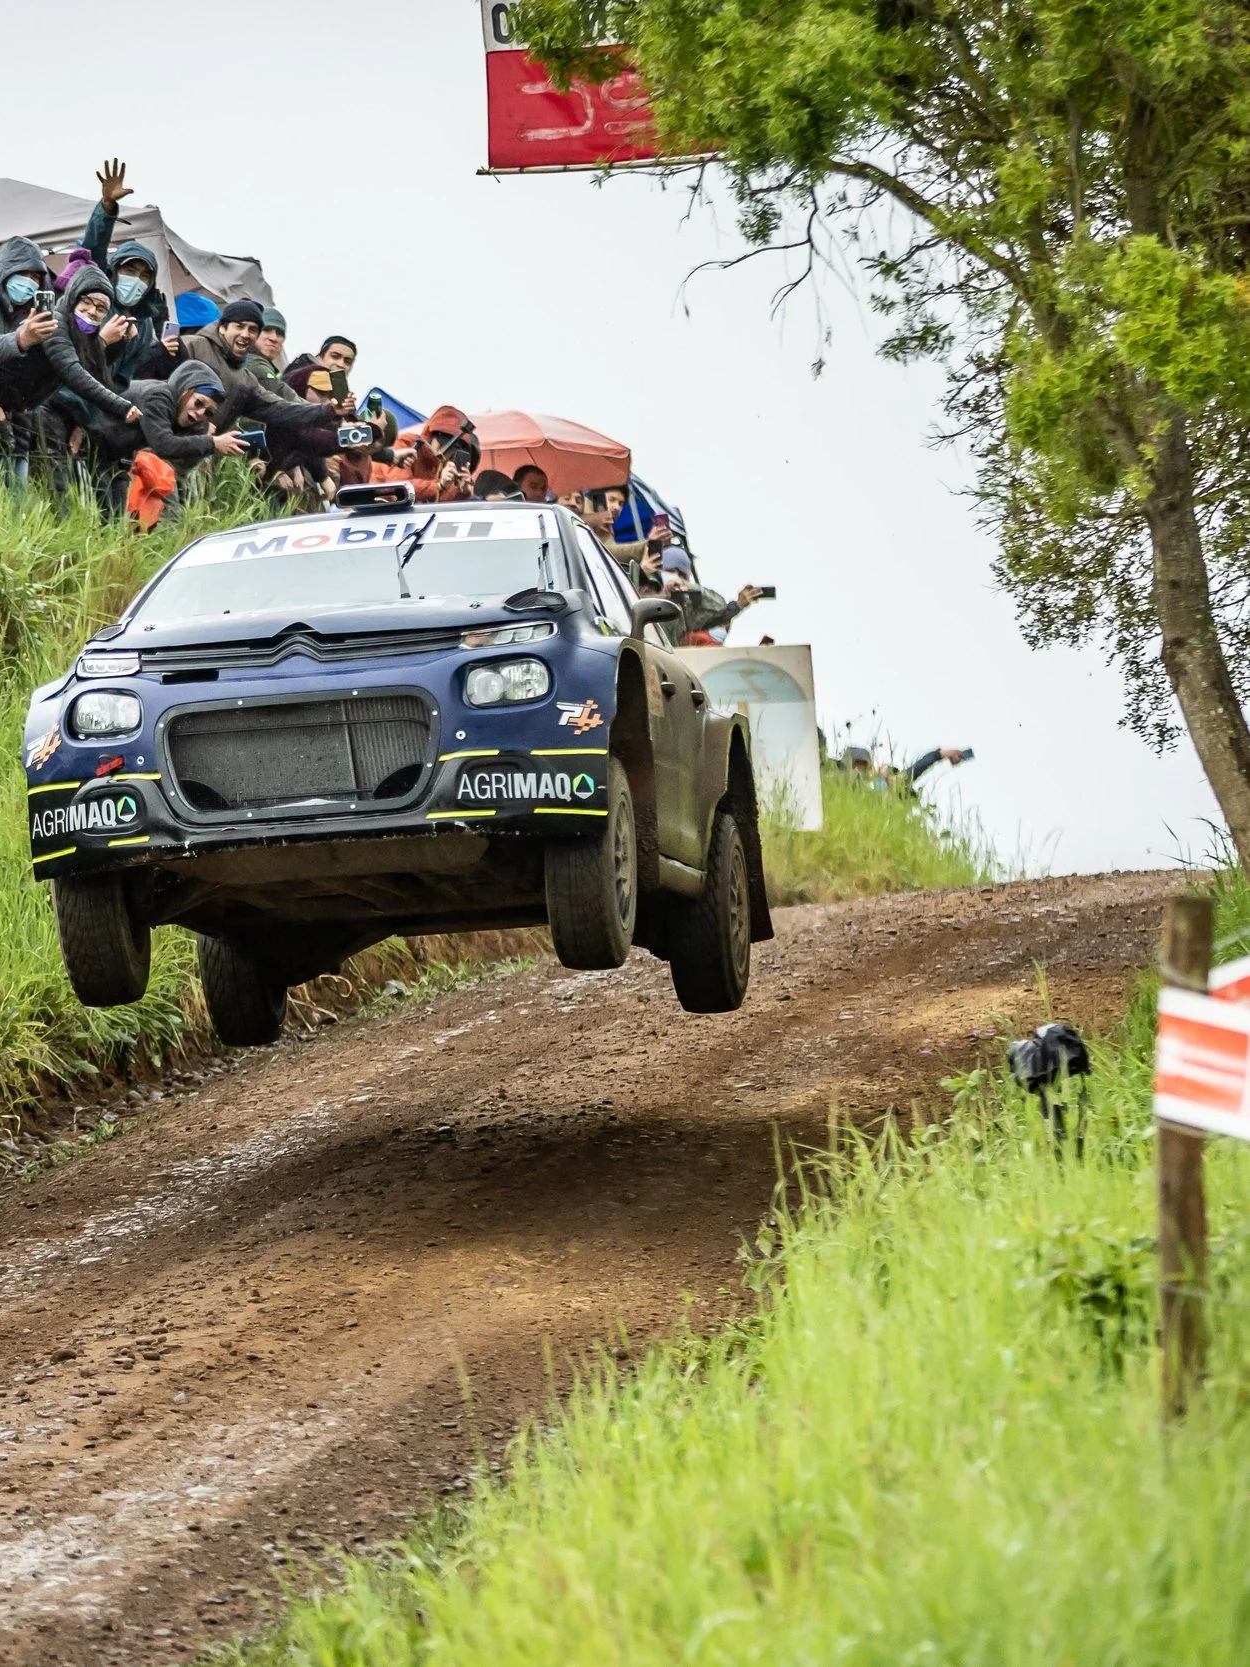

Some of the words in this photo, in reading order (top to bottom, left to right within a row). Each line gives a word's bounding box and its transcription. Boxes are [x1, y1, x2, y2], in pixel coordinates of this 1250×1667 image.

[232, 522, 418, 559] Mobil
[457, 773, 573, 802] AGRIMAQ
[32, 799, 117, 839] AGRIMAQ
